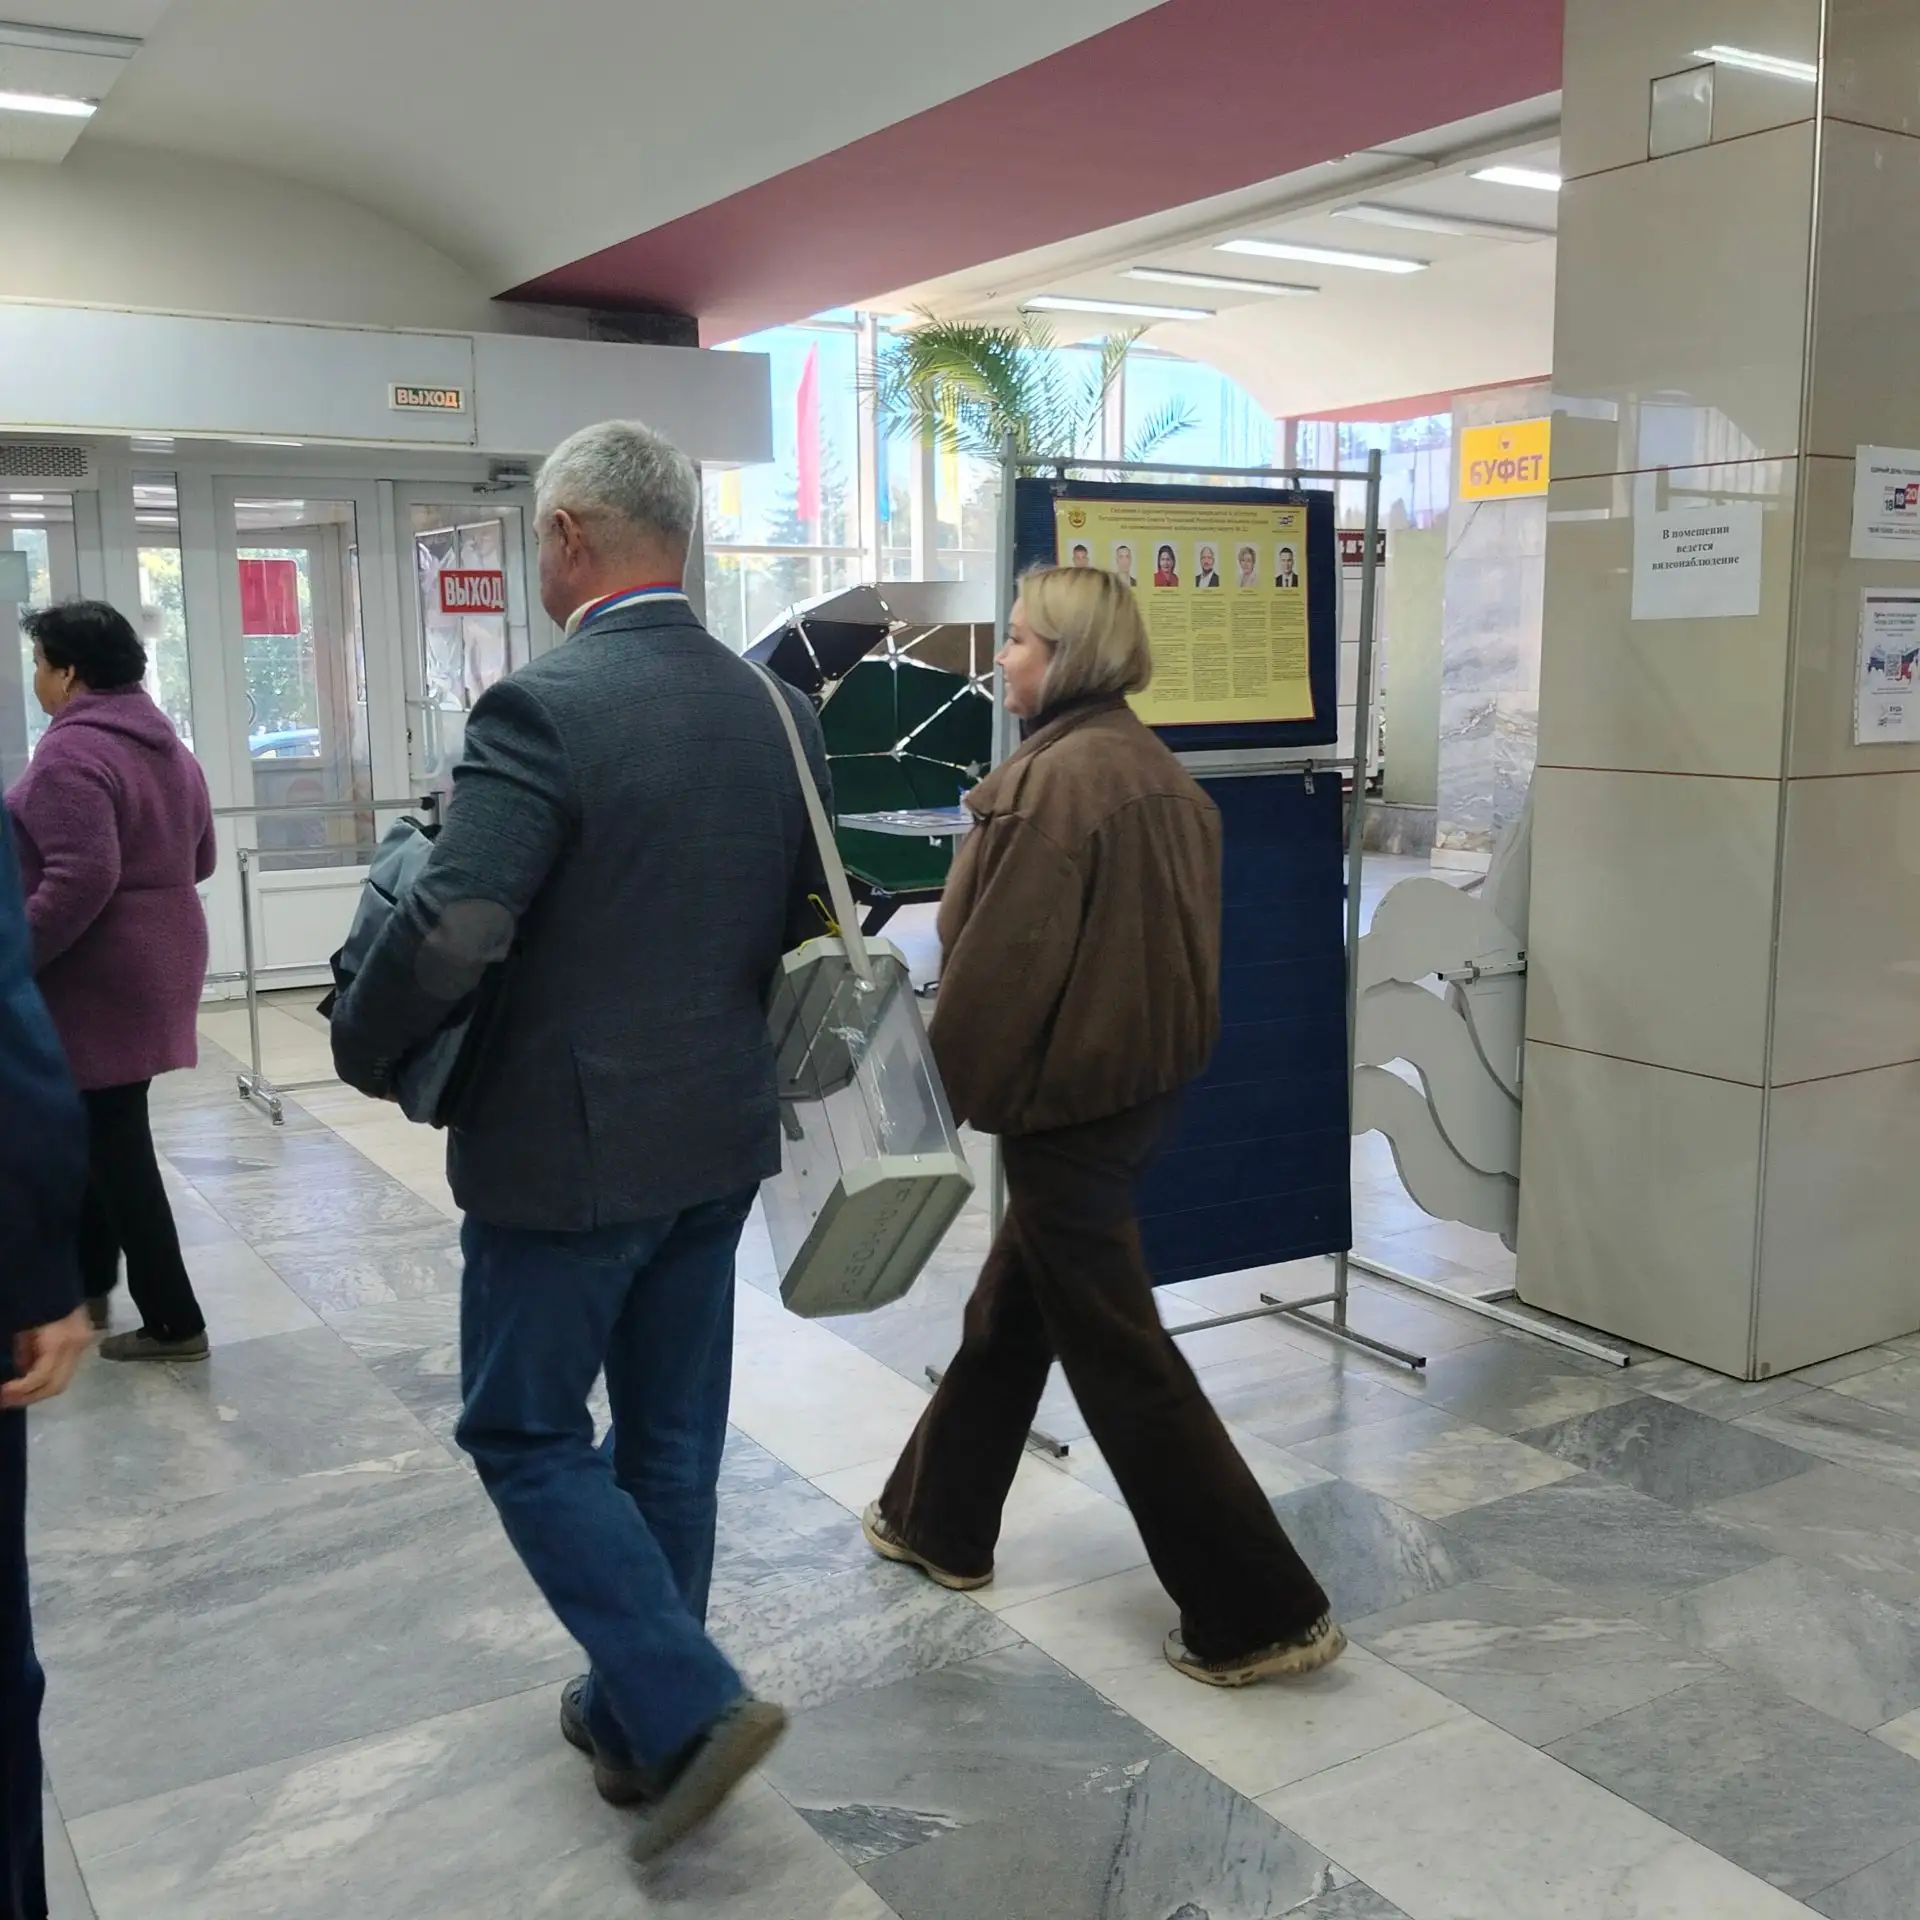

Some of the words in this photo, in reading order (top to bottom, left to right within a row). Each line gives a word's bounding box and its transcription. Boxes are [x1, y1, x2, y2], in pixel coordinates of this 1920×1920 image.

[397, 389, 457, 408] ВЫХОД
[1469, 454, 1543, 486] БУФЕТ
[1662, 529, 1670, 540] В
[1676, 542, 1714, 553] ведется
[1651, 556, 1740, 570] видеонаблюдение
[444, 576, 504, 608] ВЫХОД
